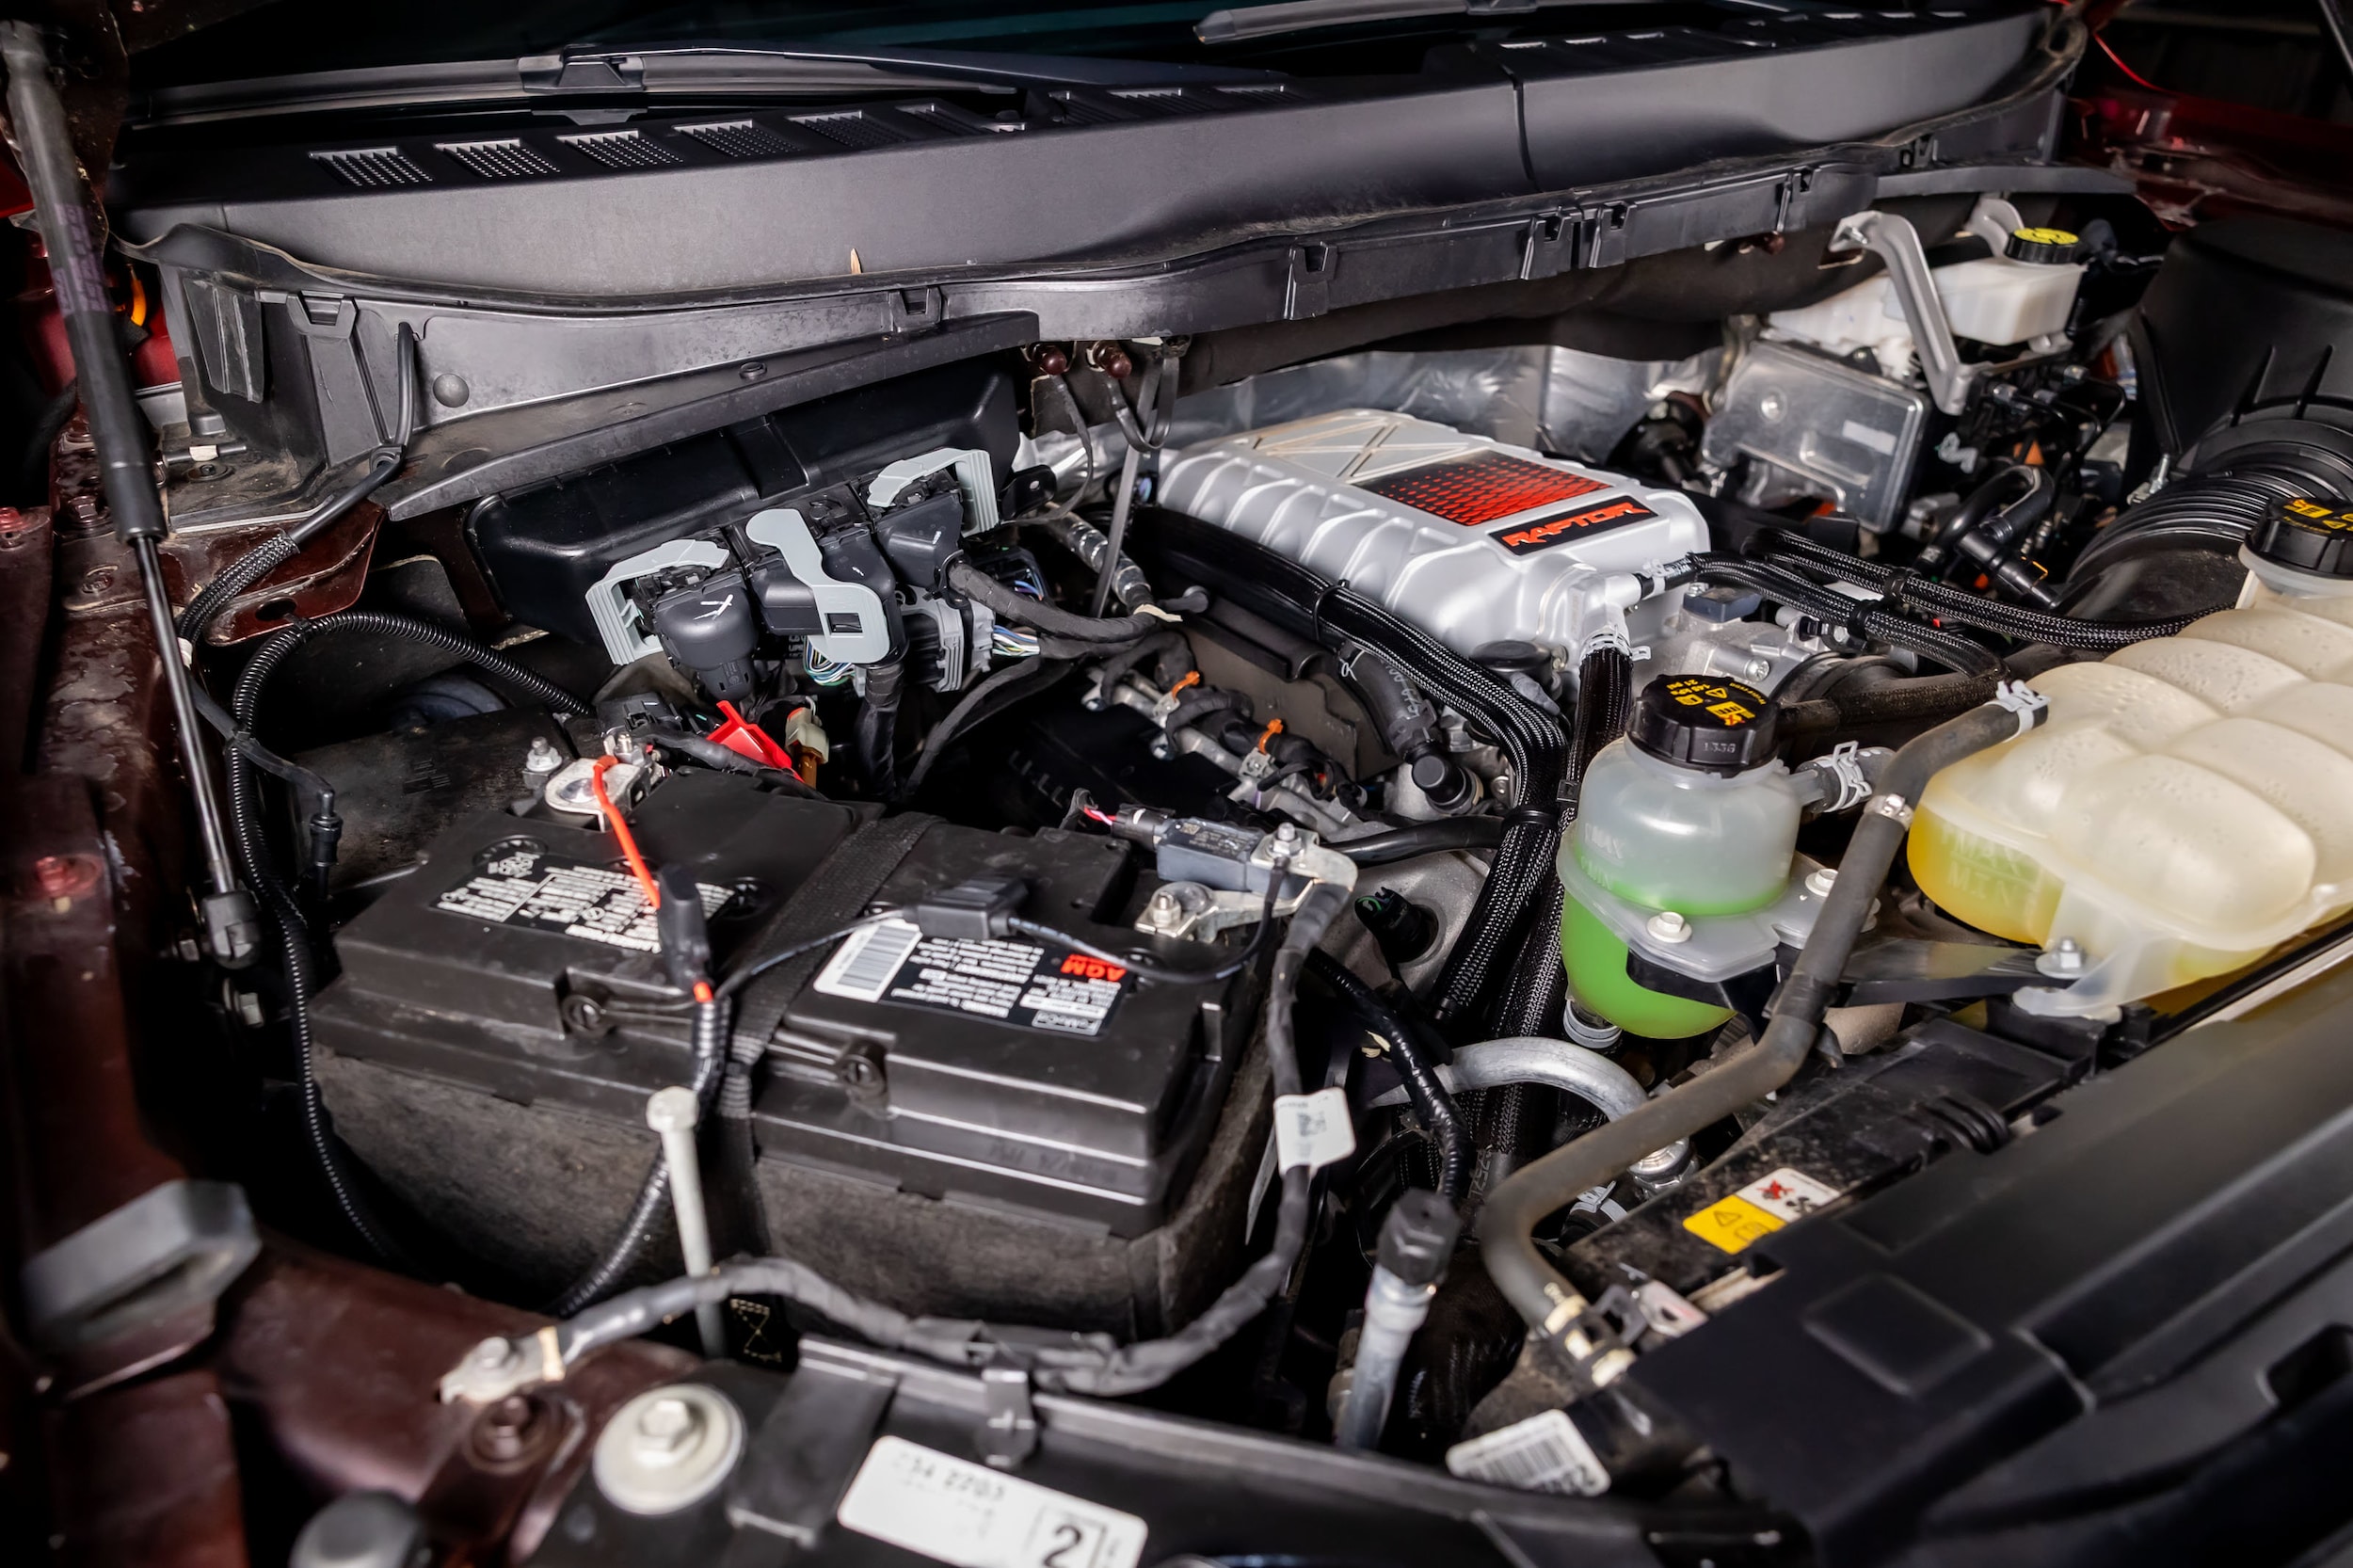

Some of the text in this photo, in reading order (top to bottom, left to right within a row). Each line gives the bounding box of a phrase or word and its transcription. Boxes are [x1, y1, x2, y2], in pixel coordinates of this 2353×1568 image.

[1501, 501, 1651, 548] RAPTOR
[1060, 956, 1128, 983] AGM
[1042, 1524, 1083, 1568] 2
